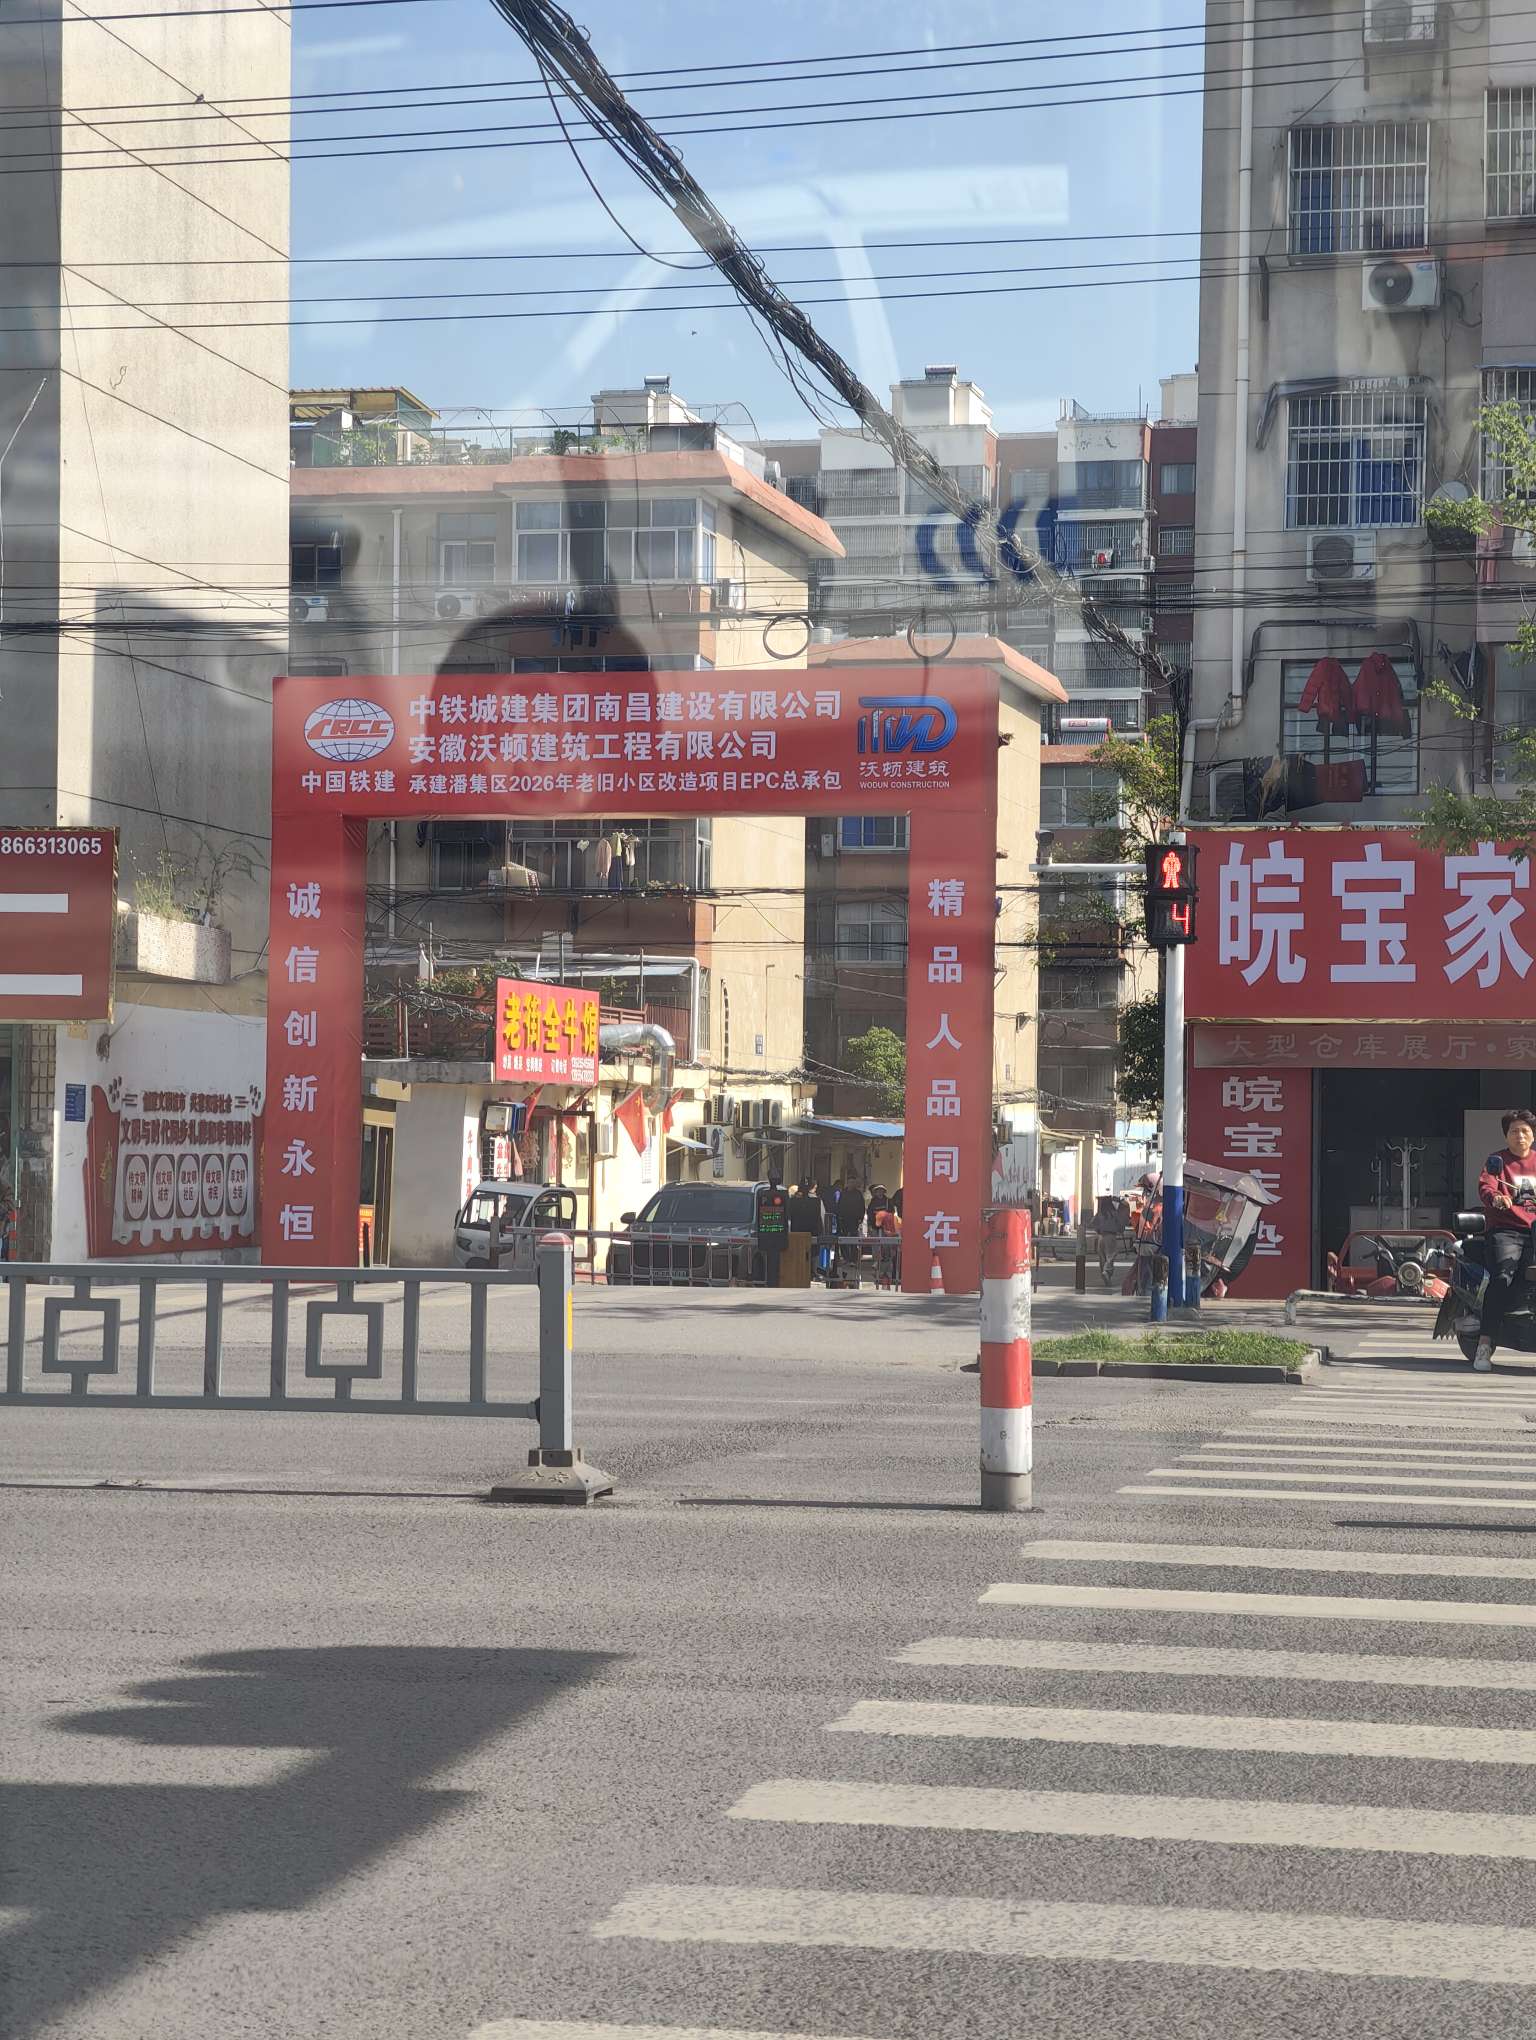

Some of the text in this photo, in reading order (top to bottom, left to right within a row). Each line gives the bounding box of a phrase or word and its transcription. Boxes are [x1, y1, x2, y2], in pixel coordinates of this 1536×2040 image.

[408, 691, 842, 724] 中铁城建集团南昌建设有限公司
[408, 730, 777, 763] 安徽沃顿建筑工程有限公司
[301, 770, 396, 794] 中国铁建
[408, 770, 842, 794] 承建潘集区2026年老旧小区改造项目EPC总承包
[859, 761, 950, 778] 沃顿建筑
[859, 780, 950, 790] WODUN CONSTRUCTION
[1, 837, 102, 854] 866313065
[1171, 903, 1190, 935] 4
[1218, 840, 1534, 988] 皖宝家
[280, 881, 322, 1242] 诚信创新永恒
[923, 878, 965, 1250] 精品人品同在
